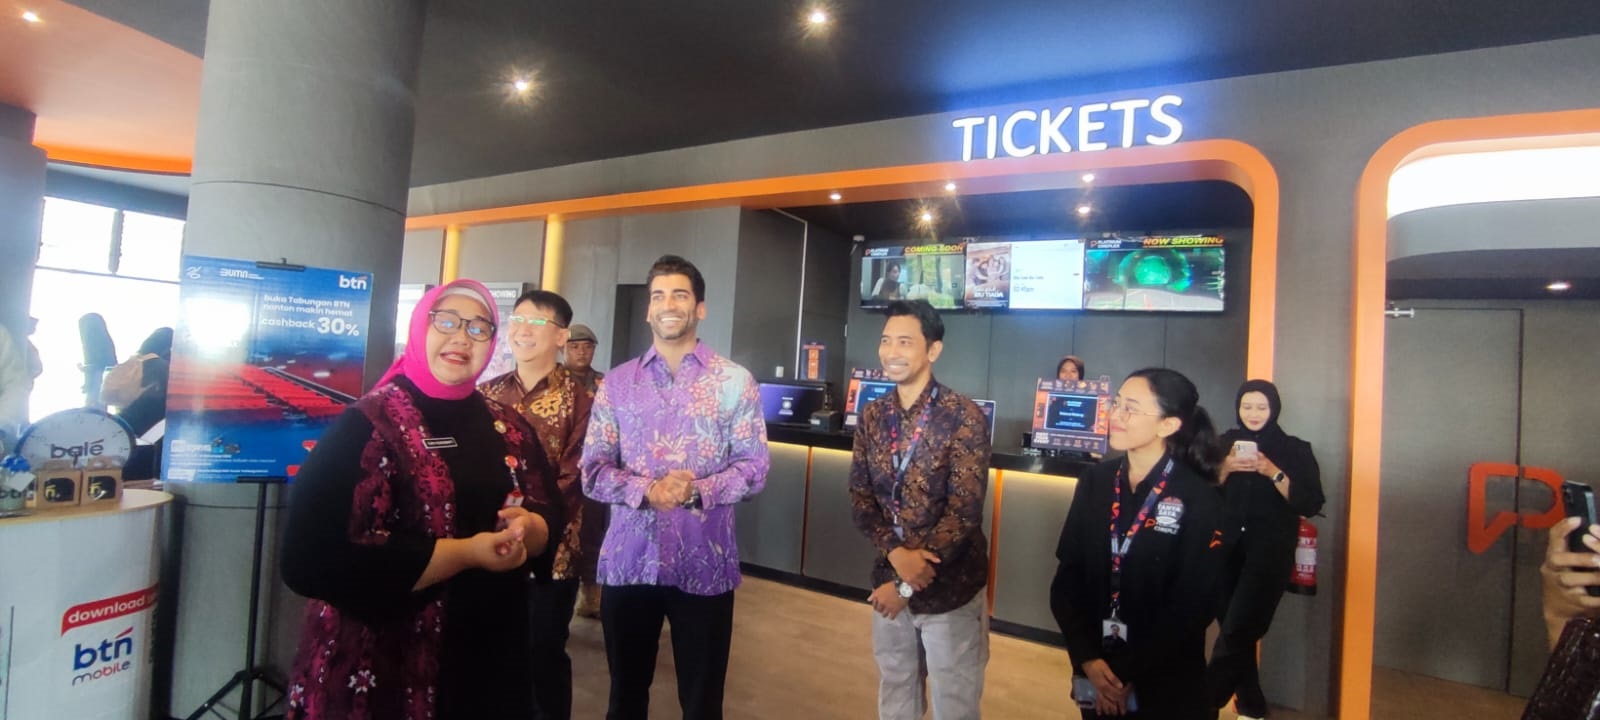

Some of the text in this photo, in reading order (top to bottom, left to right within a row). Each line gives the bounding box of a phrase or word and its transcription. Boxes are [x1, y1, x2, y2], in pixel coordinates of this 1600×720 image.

[952, 94, 1184, 162] TICKETS
[904, 243, 964, 253] COMING SOON
[1143, 236, 1224, 246] NOW SHOWING
[339, 274, 367, 290] btn
[288, 296, 332, 308] Tabungan
[333, 300, 351, 309] BTN
[296, 305, 324, 315] makin
[324, 308, 353, 317] hemat
[262, 316, 360, 337] cashback 30%
[68, 595, 145, 624] download
[73, 626, 134, 671] btn
[72, 660, 131, 686] mobile
